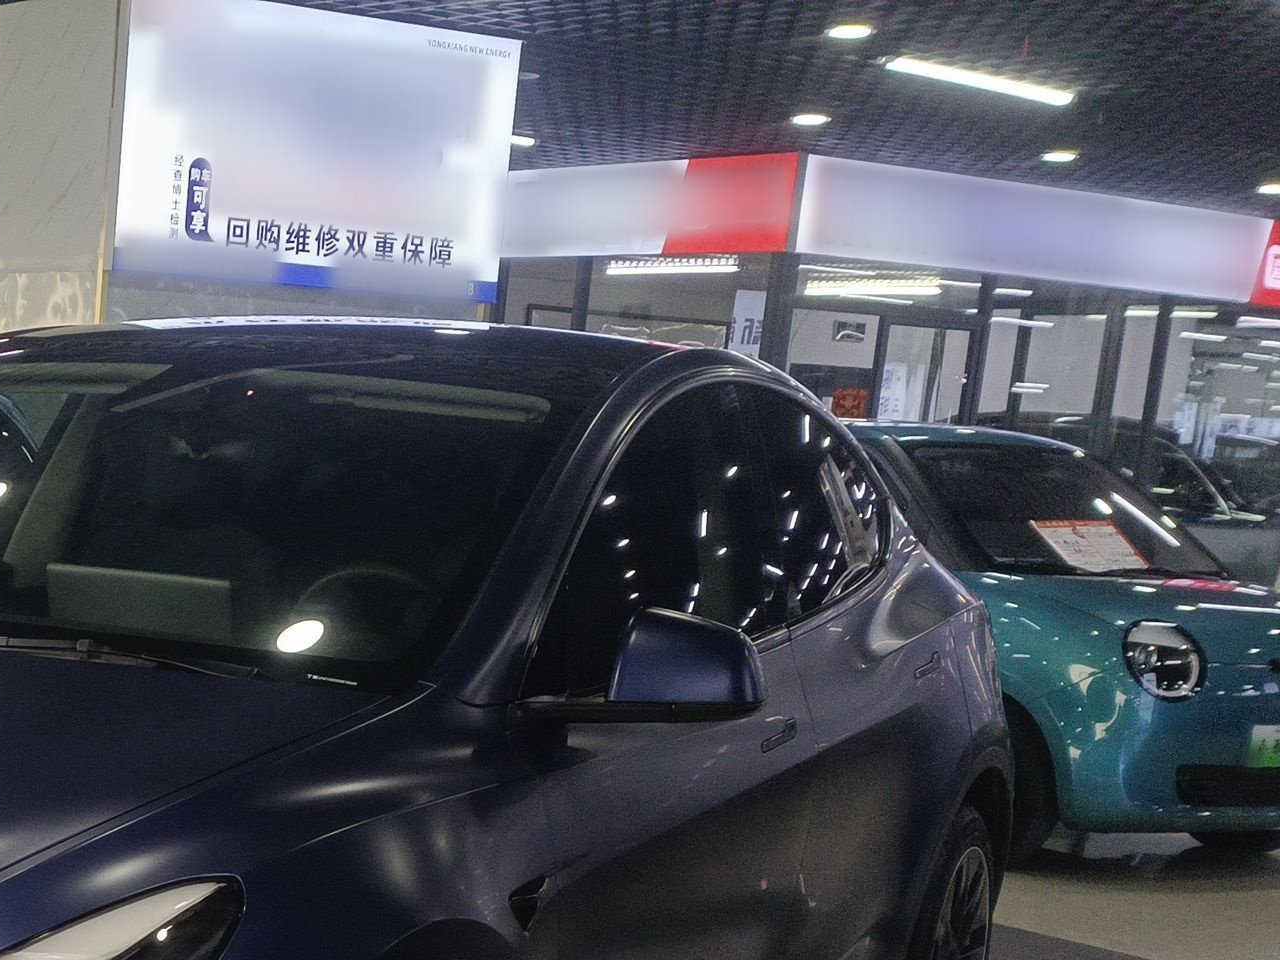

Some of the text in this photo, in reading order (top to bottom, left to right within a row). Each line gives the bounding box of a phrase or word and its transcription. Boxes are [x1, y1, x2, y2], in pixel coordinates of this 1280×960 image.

[428, 39, 512, 59] YONGXIANG NEW ENERGY
[168, 154, 184, 240] 经查博士检测
[190, 168, 211, 182] 购车
[190, 185, 208, 234] 可享
[225, 216, 454, 269] 回购维修双重保障
